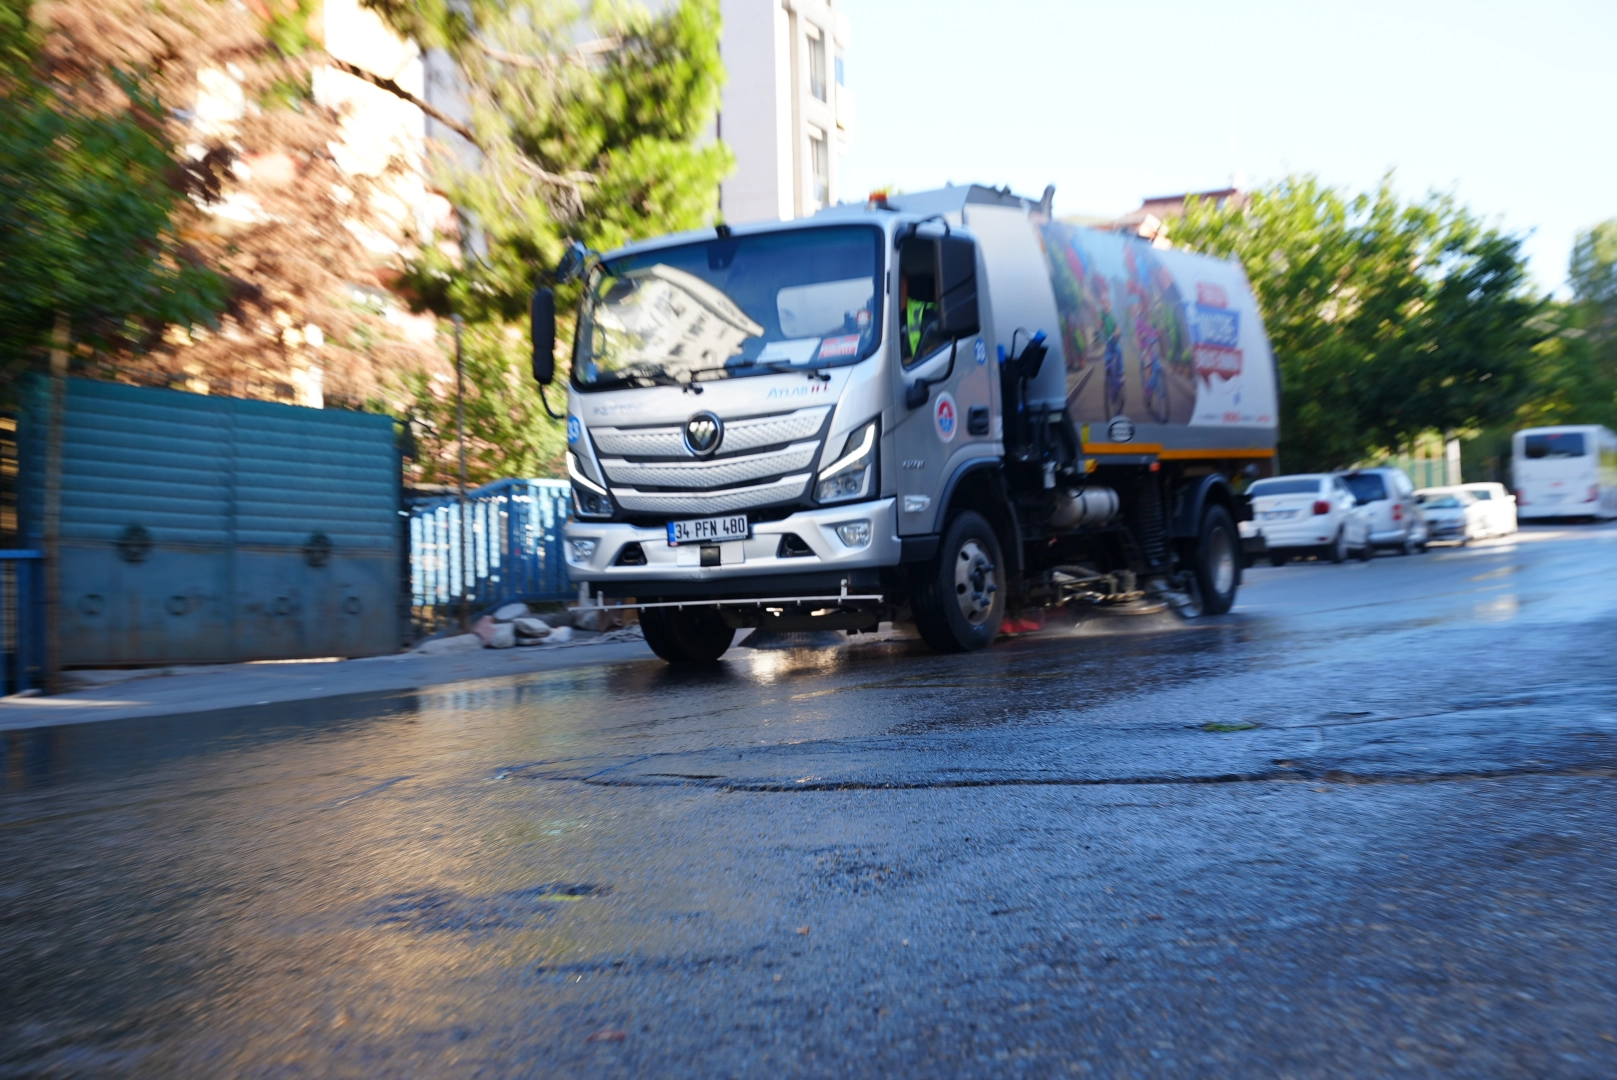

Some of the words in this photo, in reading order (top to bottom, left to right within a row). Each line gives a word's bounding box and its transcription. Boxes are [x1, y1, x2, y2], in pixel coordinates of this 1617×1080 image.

[675, 523, 690, 539] 34
[695, 520, 717, 538] PFN
[723, 517, 745, 535] 480
